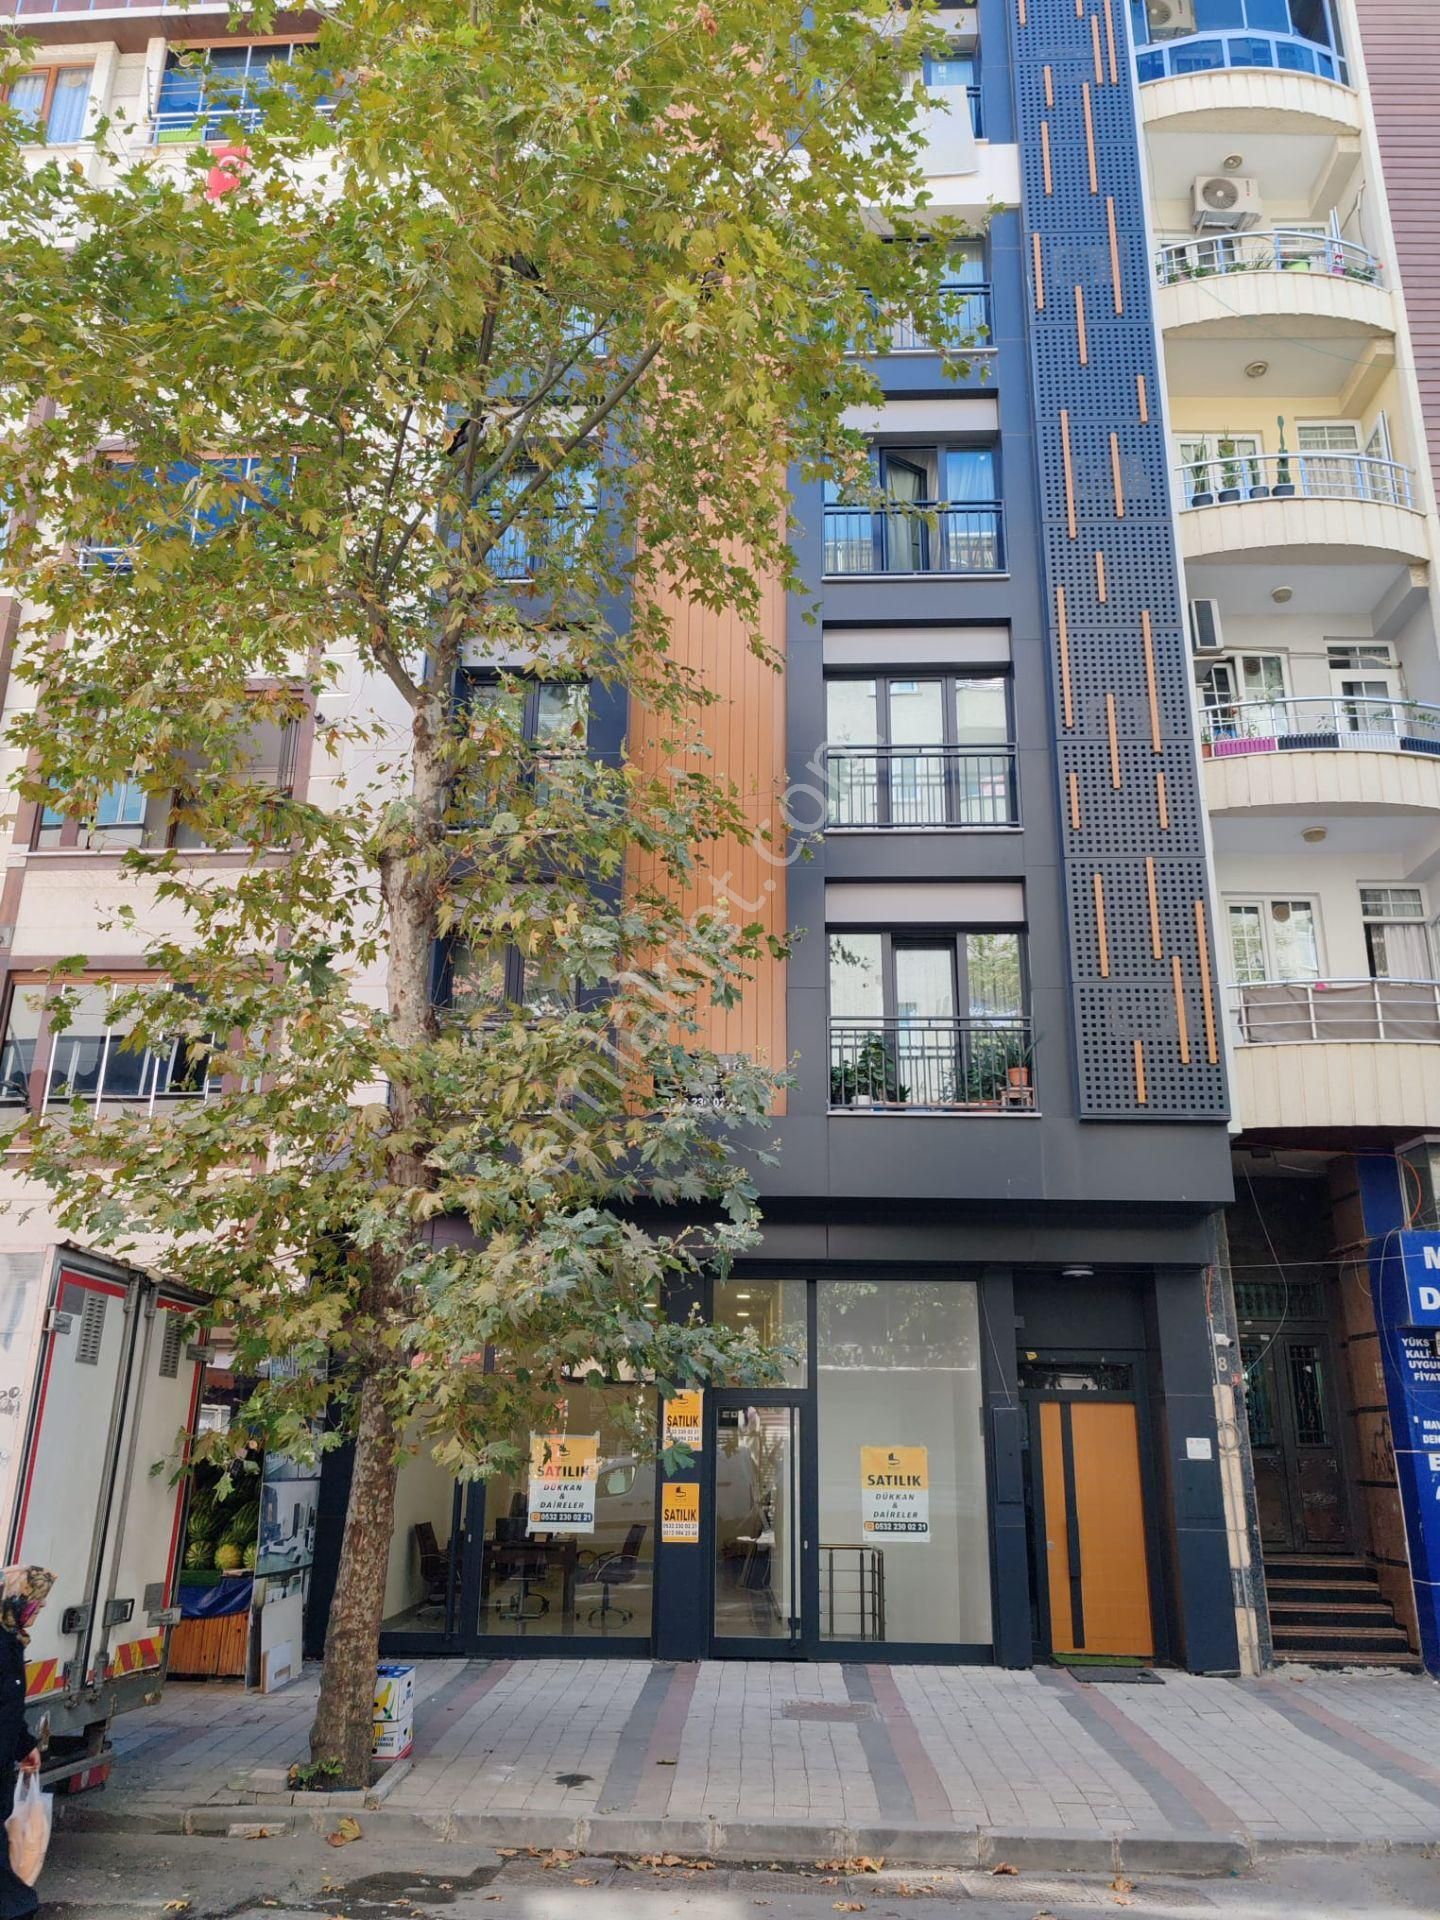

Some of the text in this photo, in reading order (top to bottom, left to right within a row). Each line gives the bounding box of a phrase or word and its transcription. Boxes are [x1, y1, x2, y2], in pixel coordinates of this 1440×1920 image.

[1218, 1356, 1228, 1371] 8
[667, 1415, 699, 1427] SATILIK
[537, 1465, 590, 1477] SATILIK
[867, 1474, 921, 1487] SATILIK
[875, 1492, 915, 1501] DÜKKAN
[664, 1508, 697, 1521] SATILIK
[873, 1510, 918, 1519] DAİRELER
